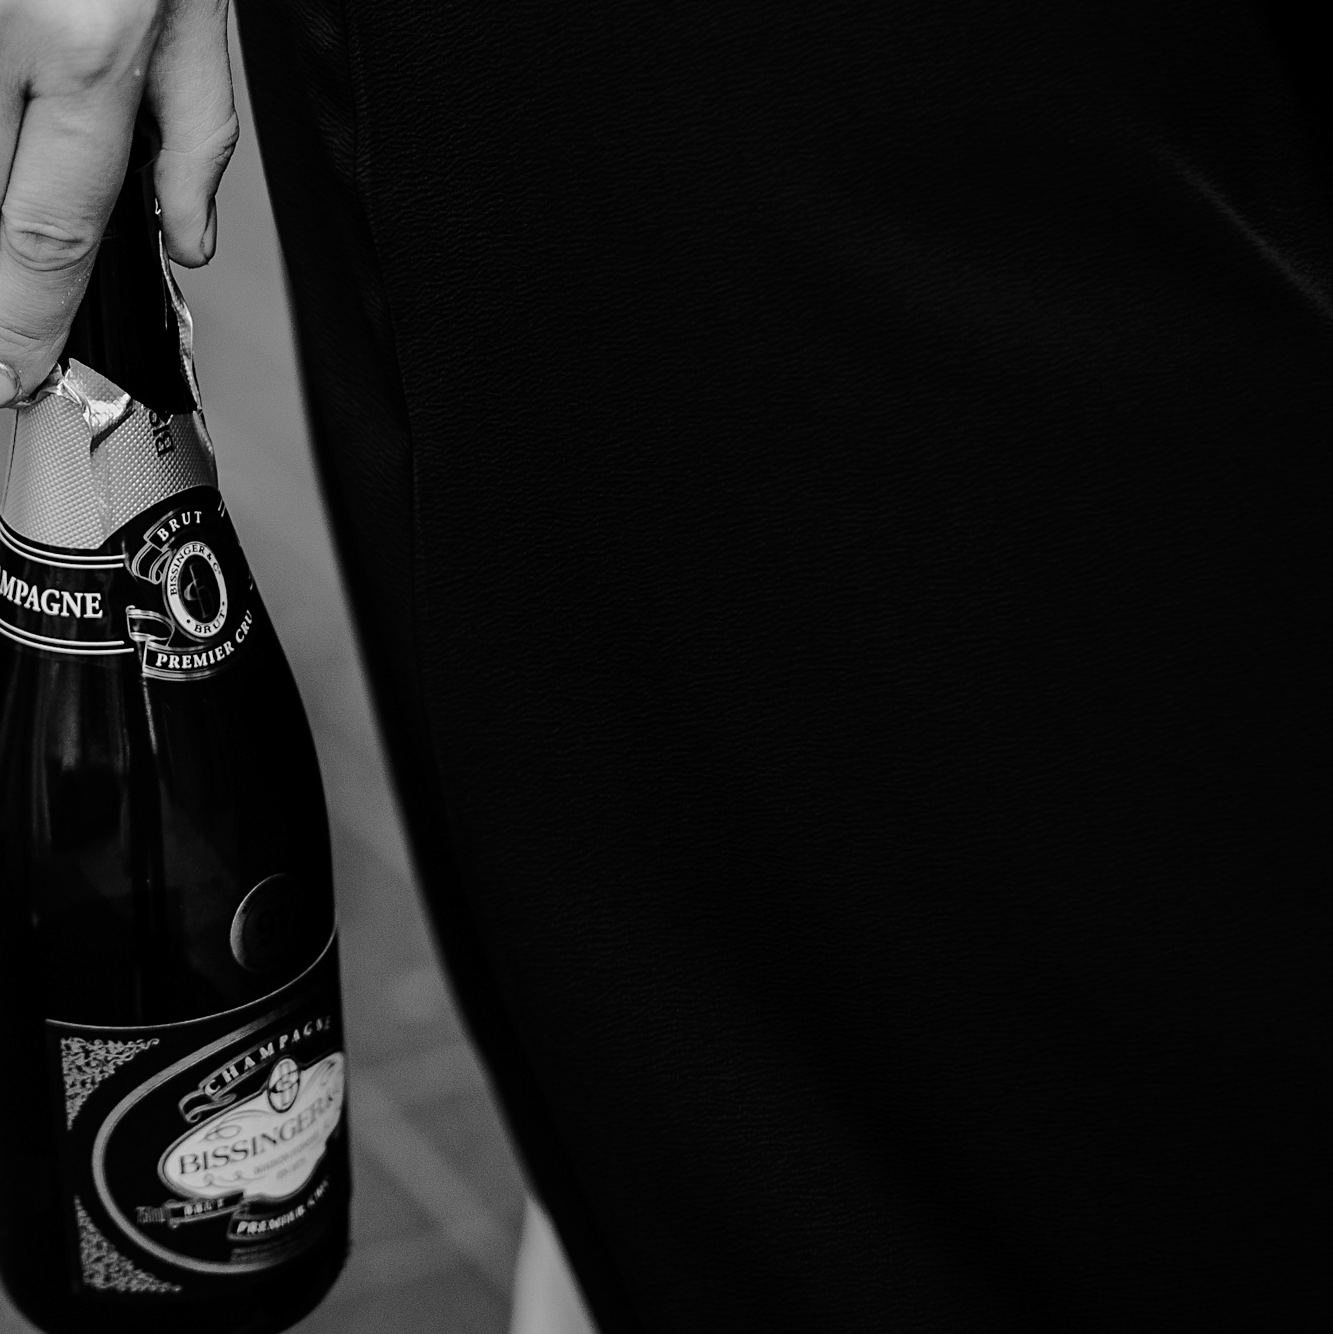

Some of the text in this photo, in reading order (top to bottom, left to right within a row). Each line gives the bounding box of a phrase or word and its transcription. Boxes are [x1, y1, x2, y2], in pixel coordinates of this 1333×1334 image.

[156, 510, 203, 542] BRUT
[170, 544, 206, 596] BISSINGER
[207, 552, 213, 562] &
[155, 609, 254, 669] PREMIER CRU
[193, 609, 227, 634] BRUT
[204, 1016, 331, 1097] CHAMPAGNE
[179, 1097, 326, 1175] BISSINGER
